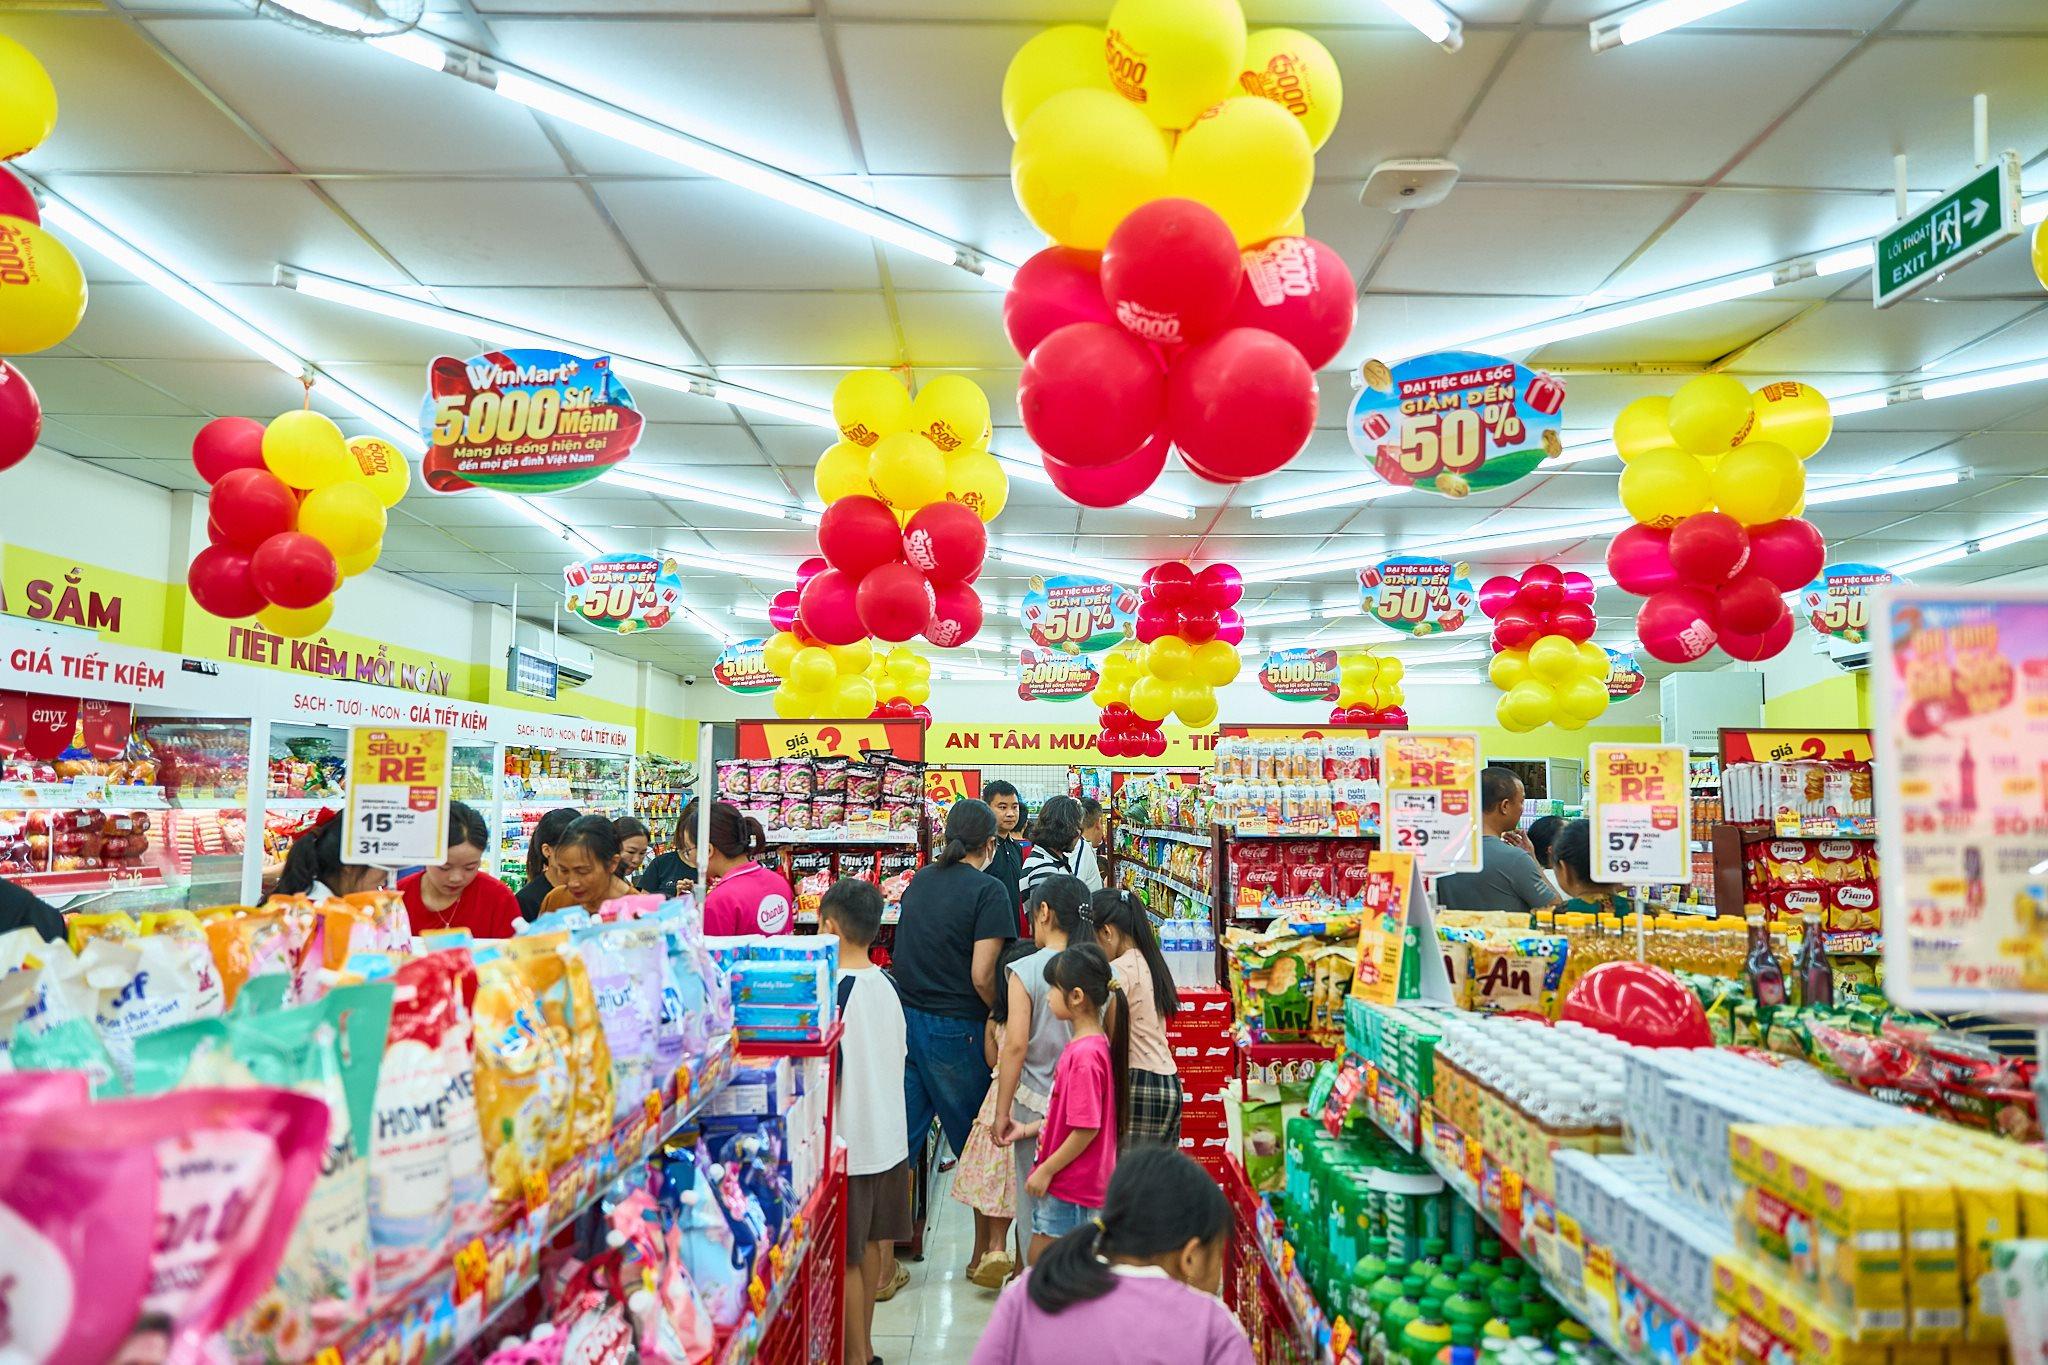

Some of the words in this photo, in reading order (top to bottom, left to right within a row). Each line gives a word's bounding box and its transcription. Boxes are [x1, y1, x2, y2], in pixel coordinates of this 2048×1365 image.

[1903, 223, 1931, 250] THOÁT
[1893, 252, 1927, 284] EXIT
[1403, 382, 1426, 395] ĐẠI
[1429, 378, 1459, 392] TIỆC
[1460, 371, 1483, 385] GIÁ
[1486, 366, 1513, 381] SỐC
[563, 386, 592, 409] Sứ
[1400, 392, 1460, 415] GIẢM
[1466, 383, 1515, 406] ĐẾN
[558, 409, 619, 437] Mệnh
[453, 444, 492, 459] Mang
[515, 442, 548, 457] sống
[552, 439, 582, 453] hiện
[585, 437, 607, 452] đại
[1400, 402, 1521, 474] 50%
[458, 460, 480, 471] đến
[482, 460, 501, 474] mọi
[502, 459, 519, 471] gia
[546, 454, 567, 467] Việt
[569, 453, 595, 463] Nam
[592, 563, 608, 571] ĐẠI
[609, 563, 626, 571] TIỆC
[627, 562, 640, 570] GIÁ
[641, 561, 658, 570] SỐC
[1386, 566, 1403, 574] ĐẠI
[1405, 566, 1420, 574] TIỆC
[1421, 565, 1433, 573] GIÁ
[1434, 564, 1450, 573] SỐC
[590, 572, 624, 583] GIẢM
[627, 571, 657, 583] ĐẾN
[1382, 574, 1417, 585] GIẢM
[1421, 574, 1449, 585] ĐẾN
[1876, 574, 1891, 582] SỐC
[26, 567, 122, 632] SẮM
[1828, 584, 1860, 595] GIẢM
[582, 583, 657, 617] 50%
[1048, 597, 1080, 607] GIẢM
[1084, 595, 1111, 606] ĐẾN
[1377, 585, 1449, 619] 50%
[1043, 605, 1112, 640] 50%
[1824, 597, 1870, 628] 50
[10, 647, 53, 675] GIÁ
[61, 652, 109, 681] TIẾT
[114, 661, 165, 692] KIỆM
[356, 645, 396, 687] MỖI
[401, 661, 452, 697] NGÀY
[32, 709, 67, 732] envy
[293, 694, 326, 713] SẠCH
[336, 699, 362, 716] TƯƠI
[372, 704, 400, 720] NGON
[409, 703, 431, 724] GIÁ
[435, 704, 459, 728] TIẾT
[461, 709, 488, 734] KIỆM
[368, 739, 409, 756] SIÊU
[560, 730, 576, 740] NGON
[580, 726, 594, 742] GIÁ
[595, 727, 610, 744] TIẾT
[610, 730, 627, 749] KIỆM
[785, 733, 809, 751] giá
[945, 733, 979, 749] AN
[989, 729, 1040, 749] TÂM
[1050, 733, 1098, 749] MUA
[1398, 744, 1437, 761] SIÊU
[1770, 743, 1793, 761] giá
[378, 746, 426, 783] RẺ
[1411, 750, 1456, 787] RẺ
[1609, 760, 1647, 776] SIÊU
[1620, 766, 1665, 802] RẺ
[1427, 796, 1435, 809] 1
[361, 813, 392, 832] 15
[360, 841, 379, 854] 31
[1397, 829, 1429, 847] 29
[1609, 832, 1640, 851] 57
[1774, 841, 1804, 853] Fiano
[1822, 840, 1851, 852] Fiano
[793, 856, 831, 868] CHIN-SU
[839, 855, 875, 866] CHIN-SU
[1609, 860, 1631, 873] 69
[1788, 893, 1818, 903] Fiano
[1841, 889, 1871, 900] Fiano
[760, 902, 785, 923] Chanté
[1844, 937, 1873, 953] 50%
[1476, 956, 1532, 996] An
[378, 1098, 449, 1140] HOME
